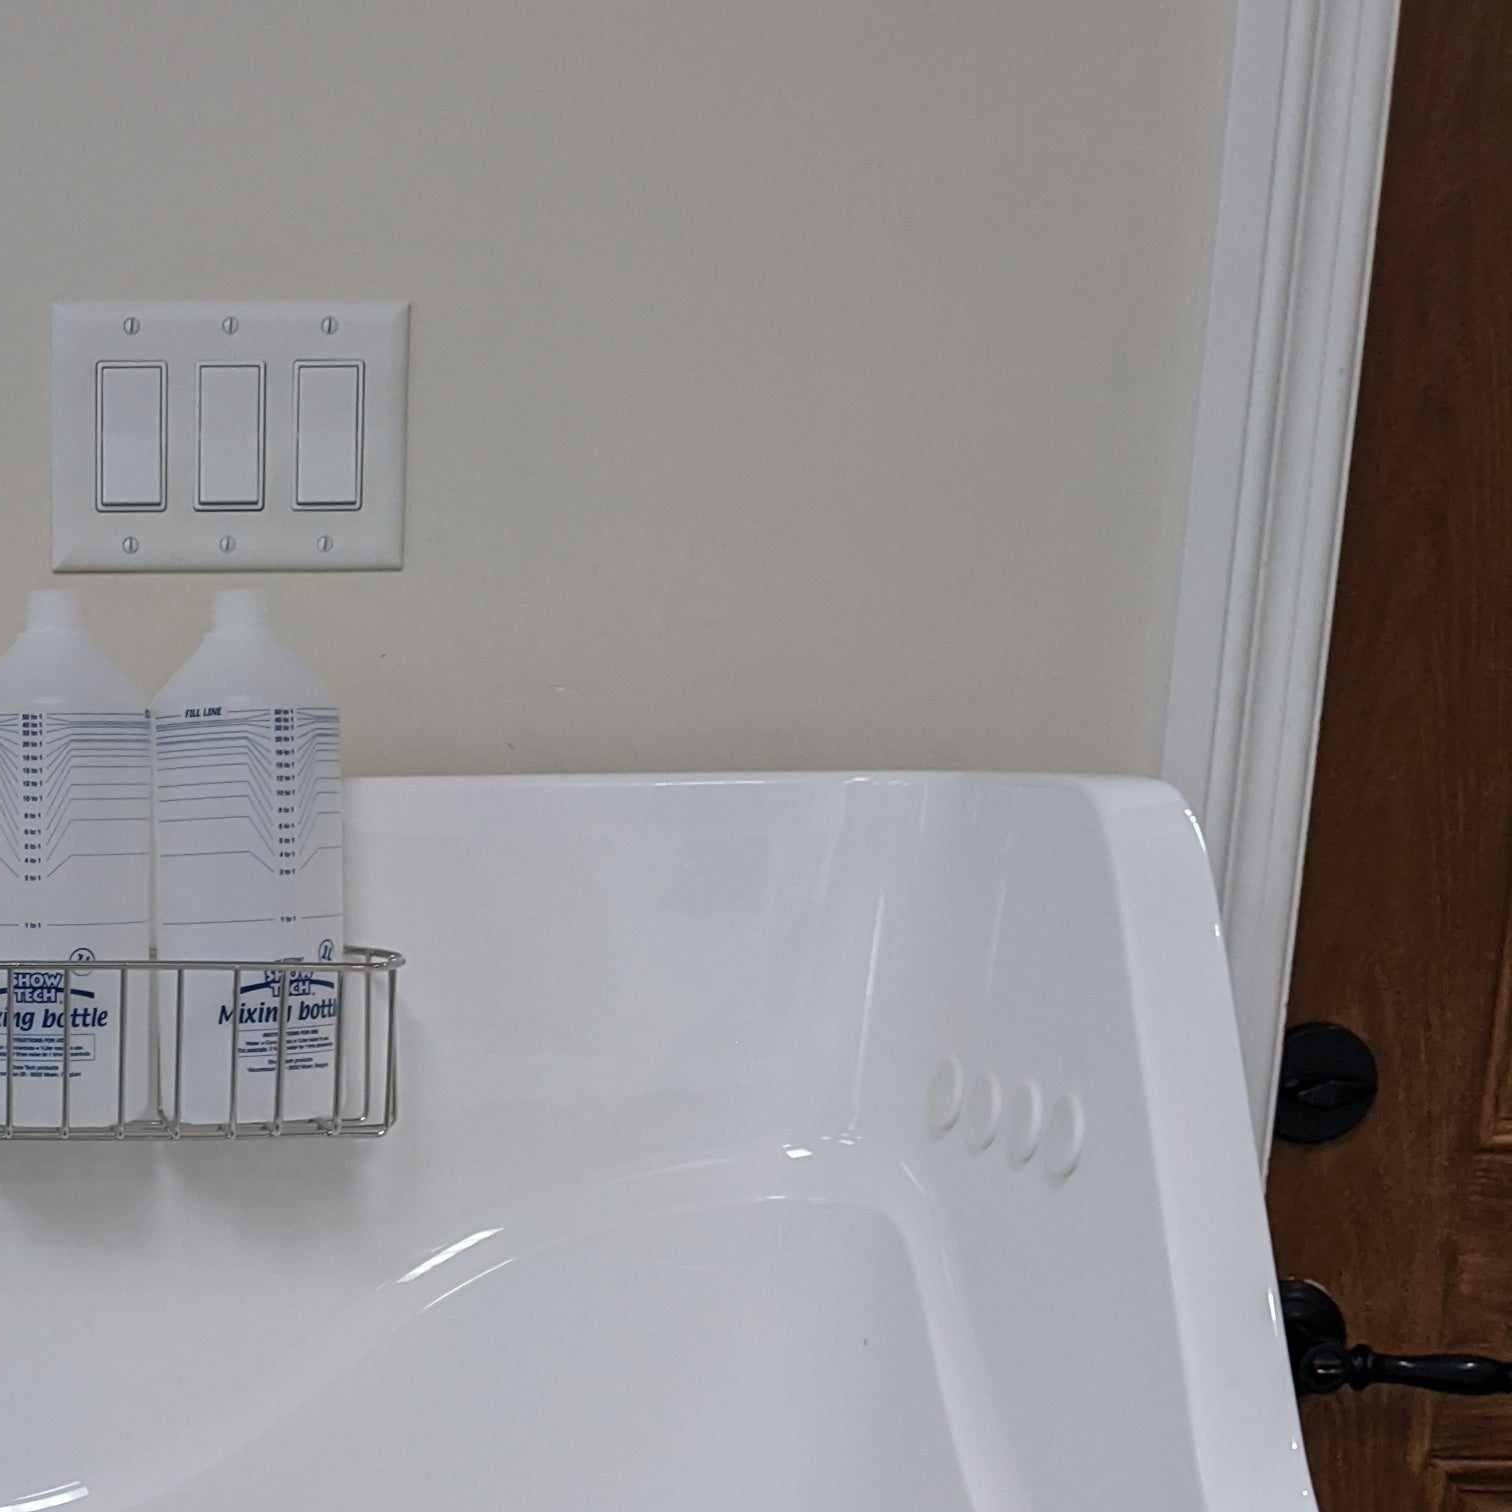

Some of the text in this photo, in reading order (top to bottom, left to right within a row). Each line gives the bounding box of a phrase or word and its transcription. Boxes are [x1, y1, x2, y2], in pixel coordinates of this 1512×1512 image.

[15, 988, 58, 1003] TECH
[269, 981, 311, 997] TCH
[298, 998, 337, 1020] bottl
